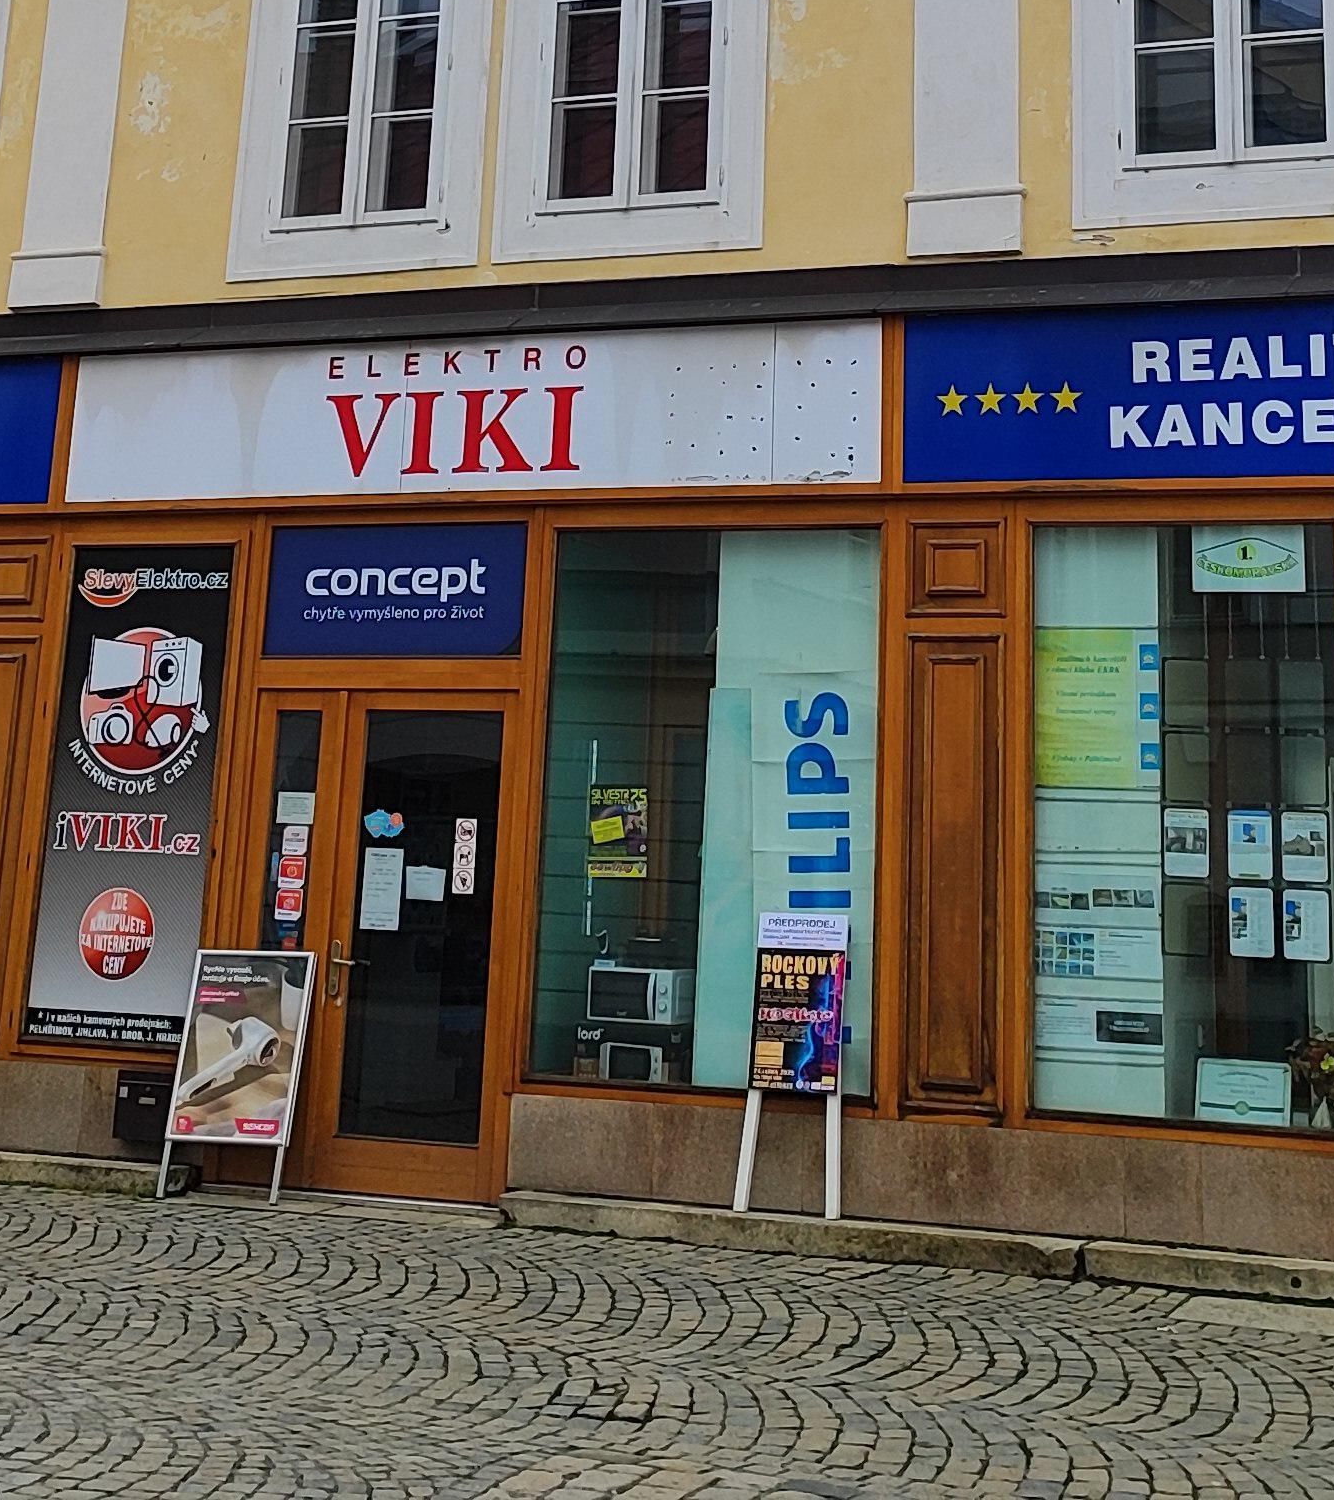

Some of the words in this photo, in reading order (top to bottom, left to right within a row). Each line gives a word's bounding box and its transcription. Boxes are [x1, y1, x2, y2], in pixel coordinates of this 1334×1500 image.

[327, 344, 588, 380] ELEKTRO
[325, 385, 585, 478] VIKI
[83, 567, 229, 594] SlevyElektro.cz
[305, 558, 487, 603] concept
[303, 605, 347, 622] chytře
[349, 605, 420, 623] vymyšleno
[424, 608, 447, 621] pro
[450, 605, 485, 620] život
[68, 738, 158, 796] INTERNETOVÉ
[52, 810, 201, 856] iVIKI.cz
[111, 892, 129, 911] ZDE
[89, 913, 147, 935] NAKUPUJETE
[768, 916, 836, 929] PŘEDPRODEJ
[80, 935, 92, 948] ZA
[93, 935, 154, 954] INTERNETOVÉ
[102, 955, 127, 975] CENY
[760, 952, 845, 976] ROCKOVÝ
[760, 974, 810, 990] PLES
[577, 1026, 602, 1041] lord
